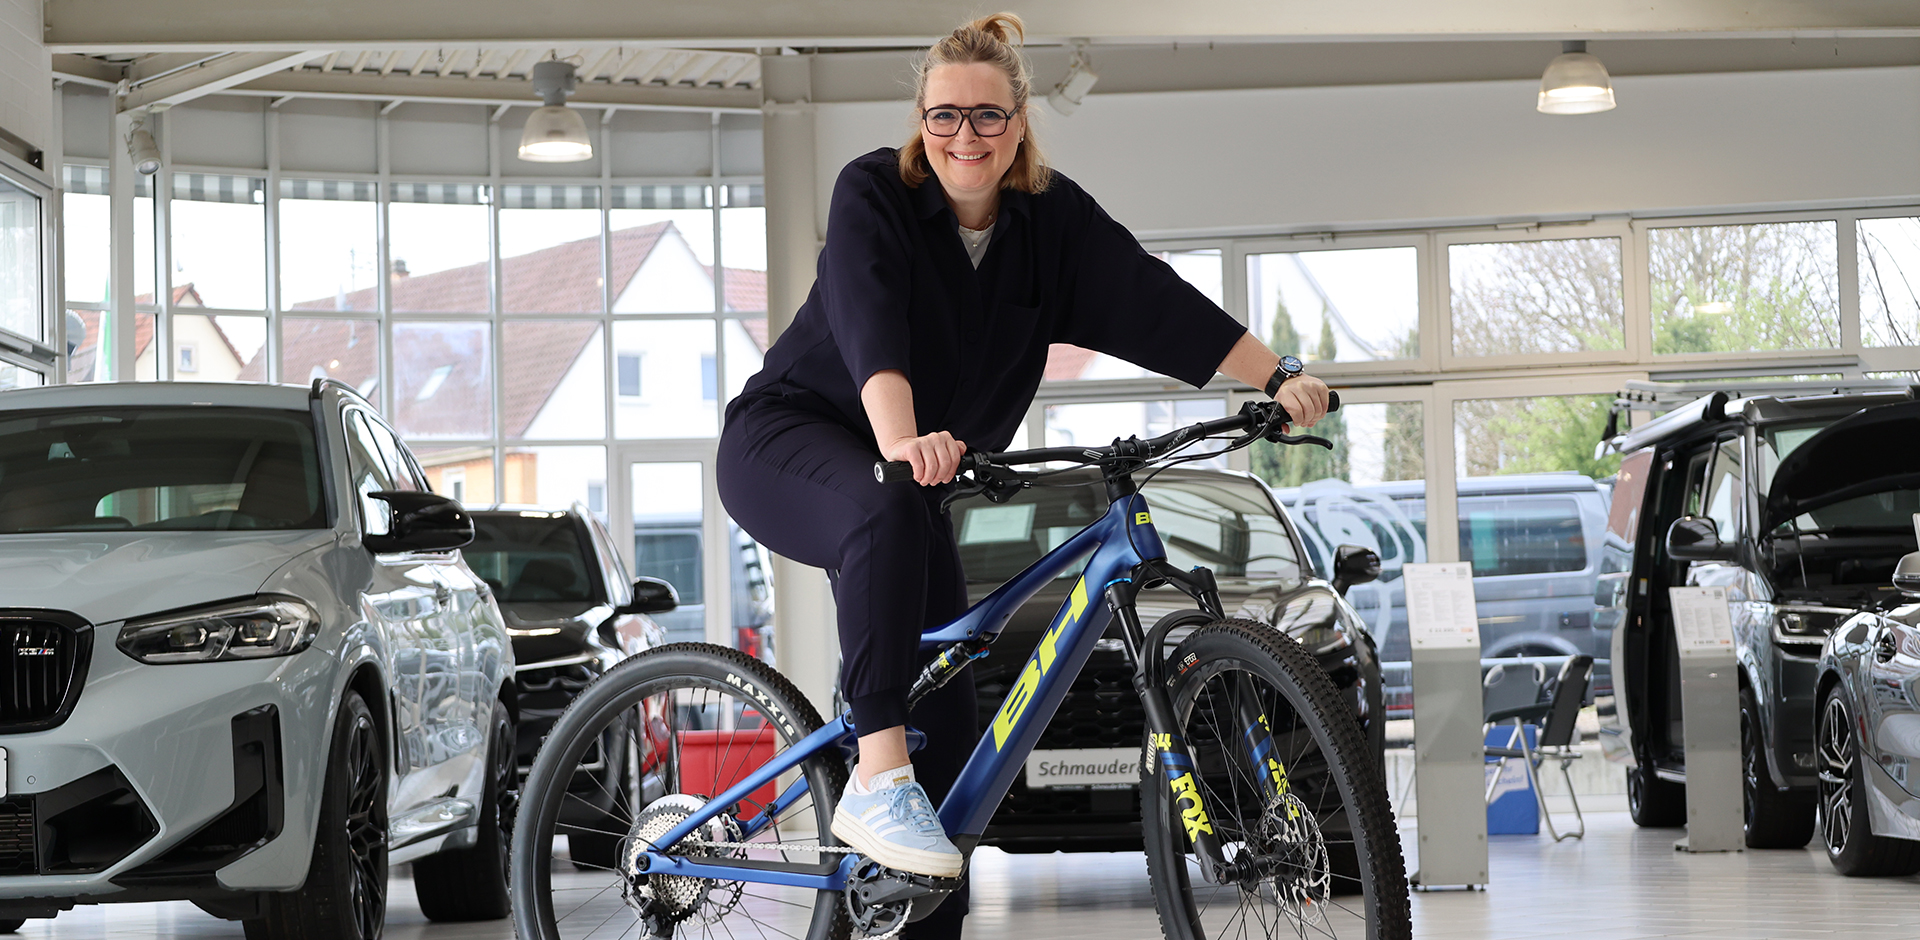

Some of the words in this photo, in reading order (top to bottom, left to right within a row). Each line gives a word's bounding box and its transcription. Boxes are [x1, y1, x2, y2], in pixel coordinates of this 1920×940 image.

[1135, 512, 1153, 525] B
[993, 575, 1089, 753] BH
[726, 673, 796, 737] MAXXIS
[1170, 772, 1213, 843] FOX
